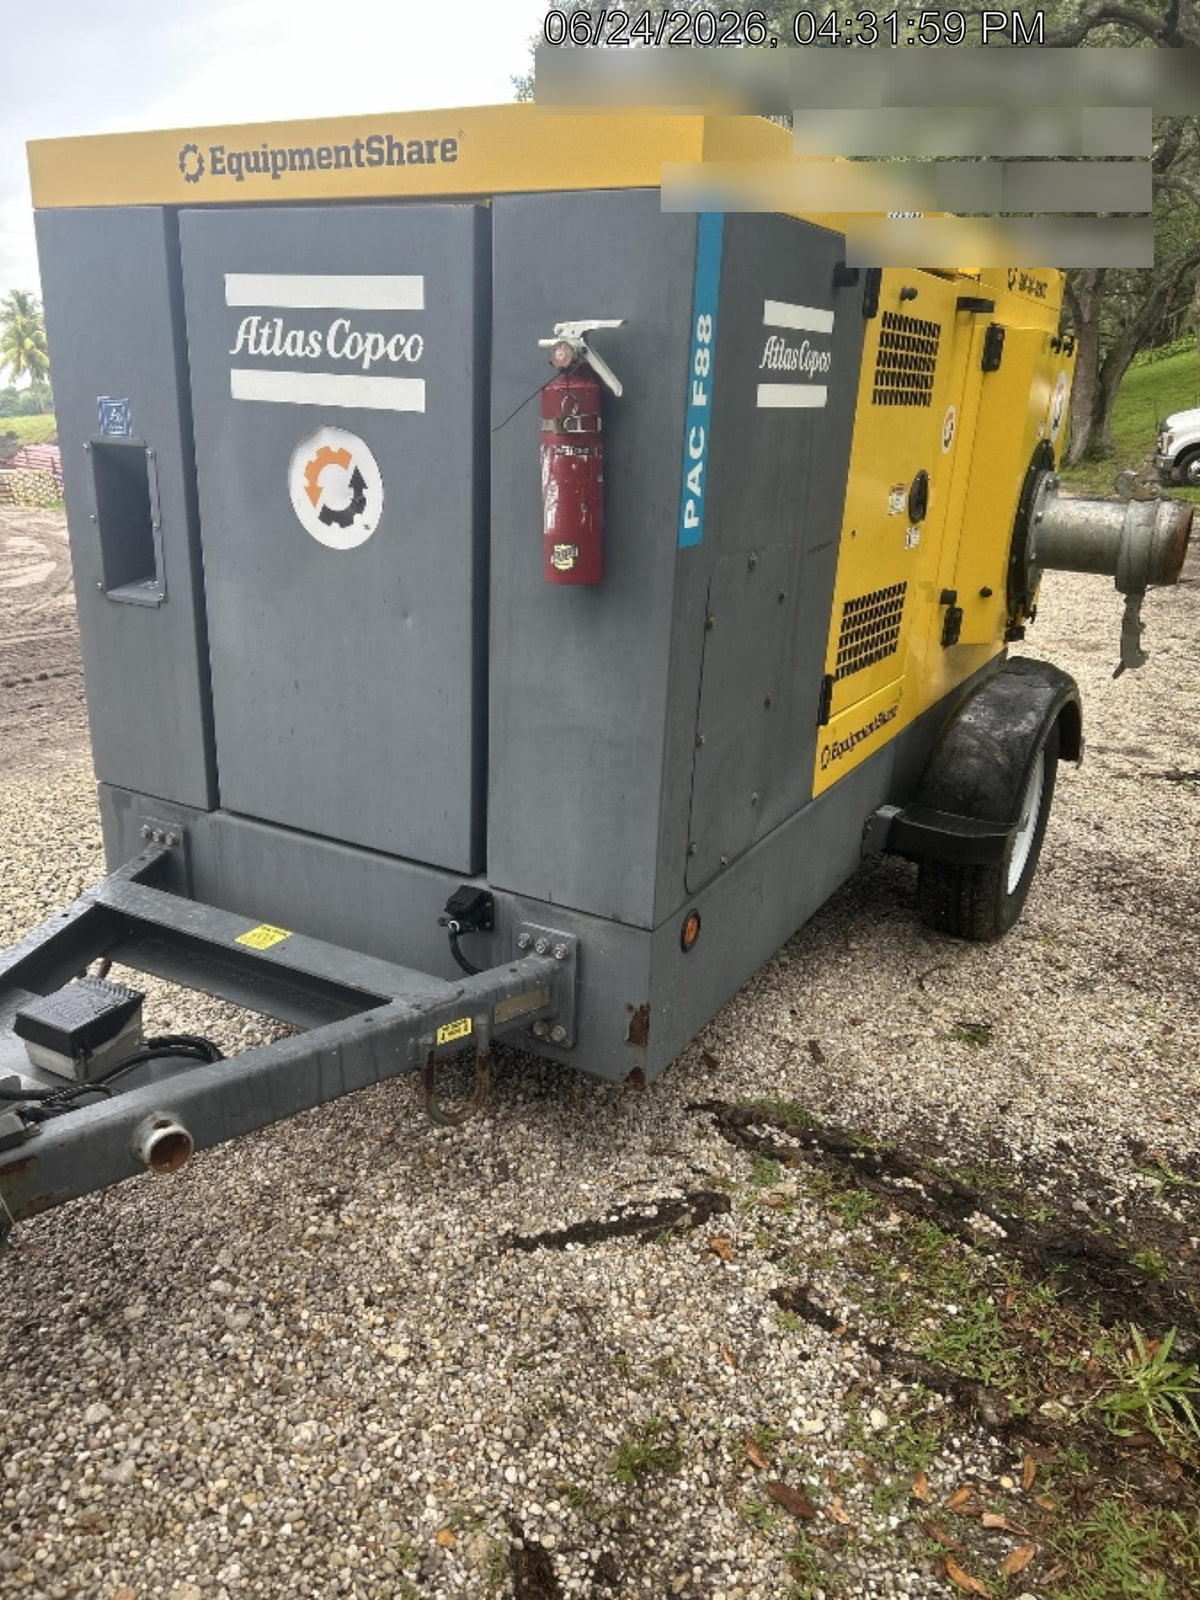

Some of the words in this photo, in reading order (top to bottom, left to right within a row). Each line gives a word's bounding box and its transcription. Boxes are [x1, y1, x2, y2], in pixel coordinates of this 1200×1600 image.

[208, 133, 459, 182] EquipmentShare
[229, 315, 322, 359] Atlas
[326, 318, 424, 370] Copco
[692, 313, 713, 407] F88
[684, 426, 705, 529] PAC
